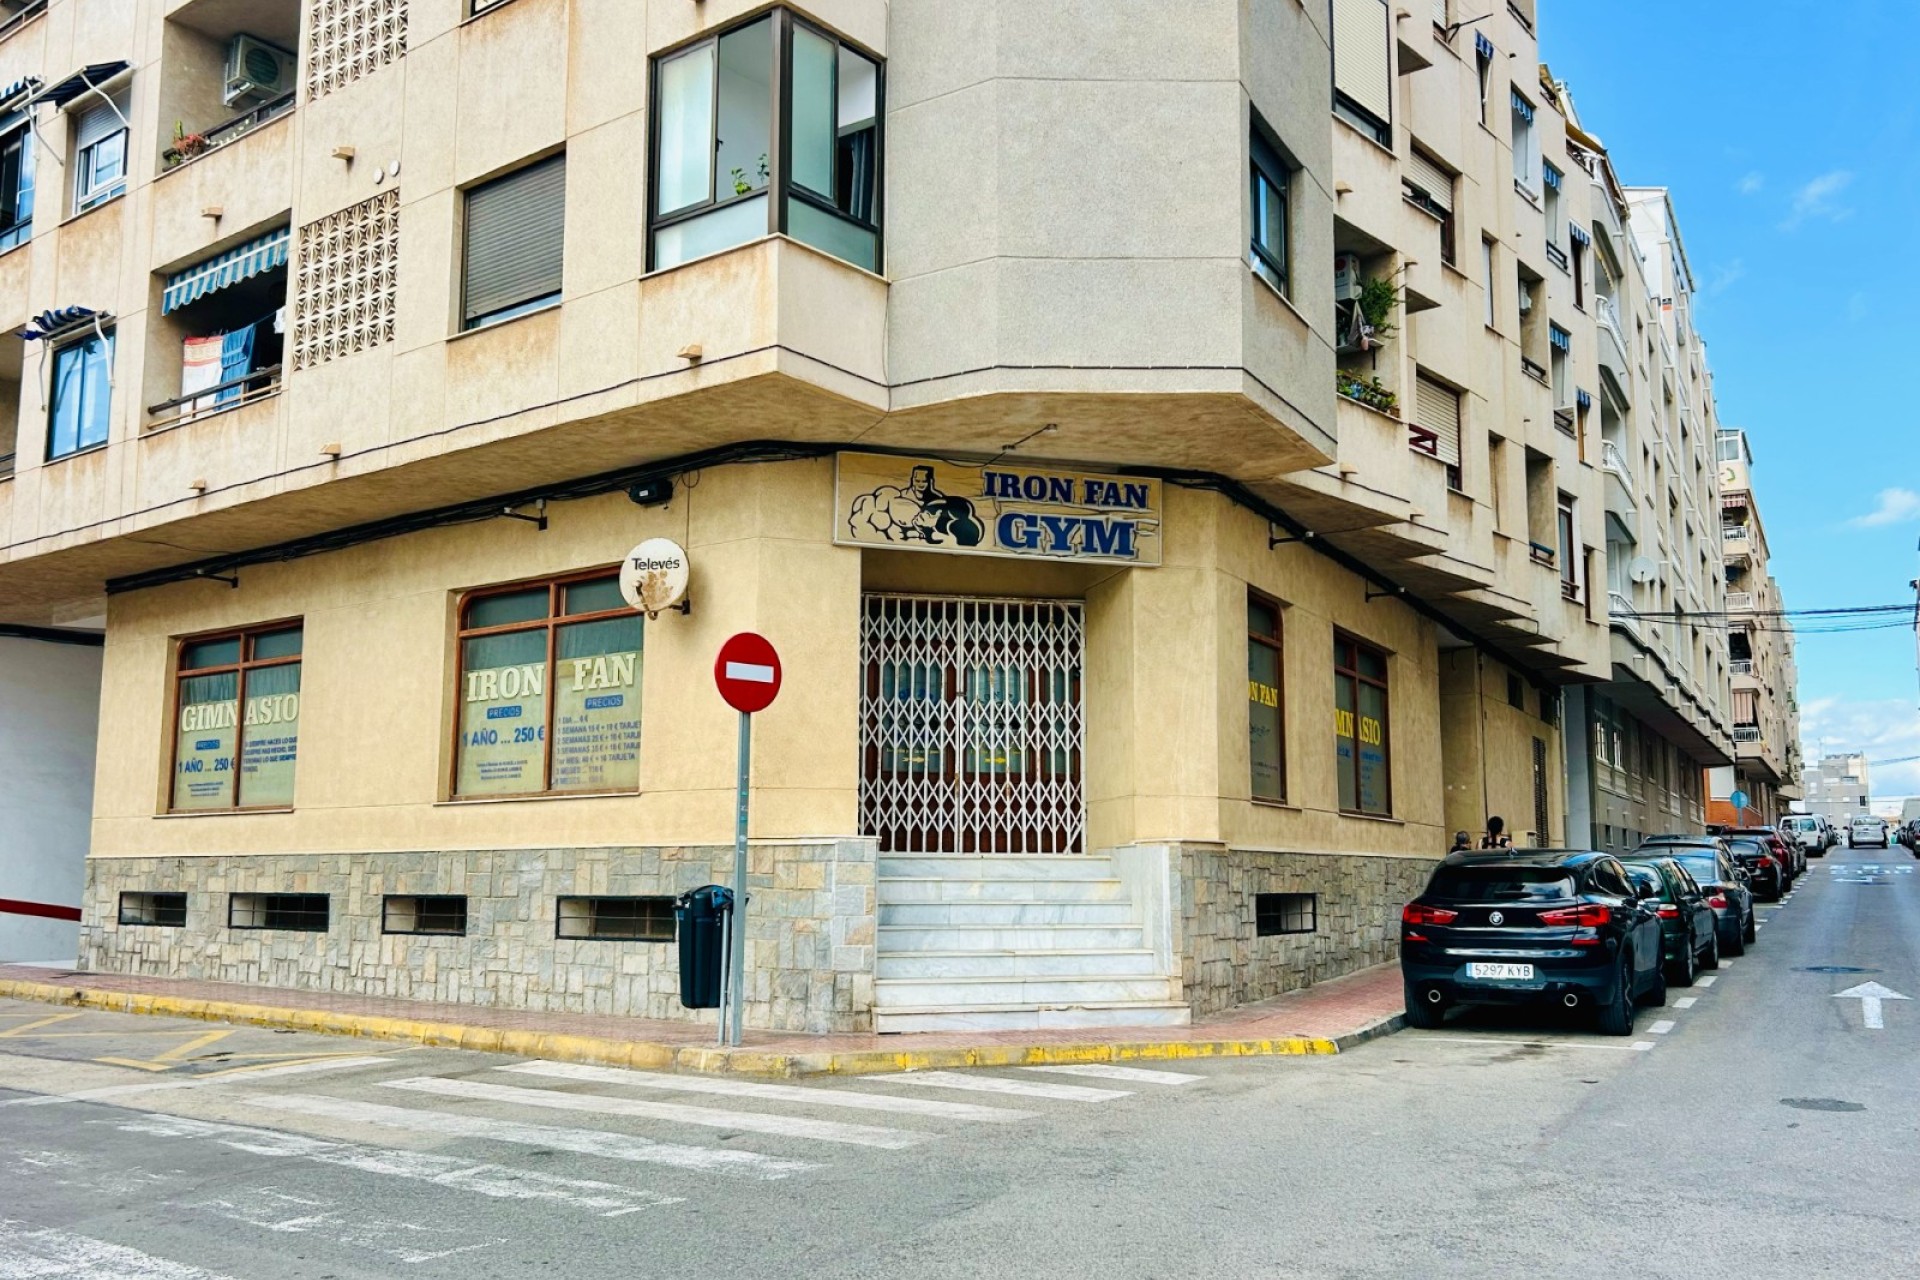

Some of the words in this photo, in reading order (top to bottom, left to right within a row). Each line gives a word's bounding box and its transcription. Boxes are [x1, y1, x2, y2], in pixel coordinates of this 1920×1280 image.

[983, 472, 1073, 502] IRON
[1084, 480, 1148, 508] FAN
[998, 512, 1135, 556] GYM
[631, 557, 680, 570] Televés
[467, 665, 545, 701] IRON
[572, 653, 636, 691] FAN
[587, 696, 621, 708] PRECIOS
[1260, 684, 1278, 707] FAN
[488, 706, 521, 717] PRECIOS
[463, 732, 468, 747] 1
[471, 728, 498, 747] AÑO
[514, 727, 534, 743] 250
[537, 725, 545, 741] €
[608, 752, 636, 761] TARJETA
[185, 757, 203, 773] AÑO
[214, 757, 229, 772] 250
[1475, 965, 1504, 976] 5297
[1507, 965, 1530, 977] KYB
